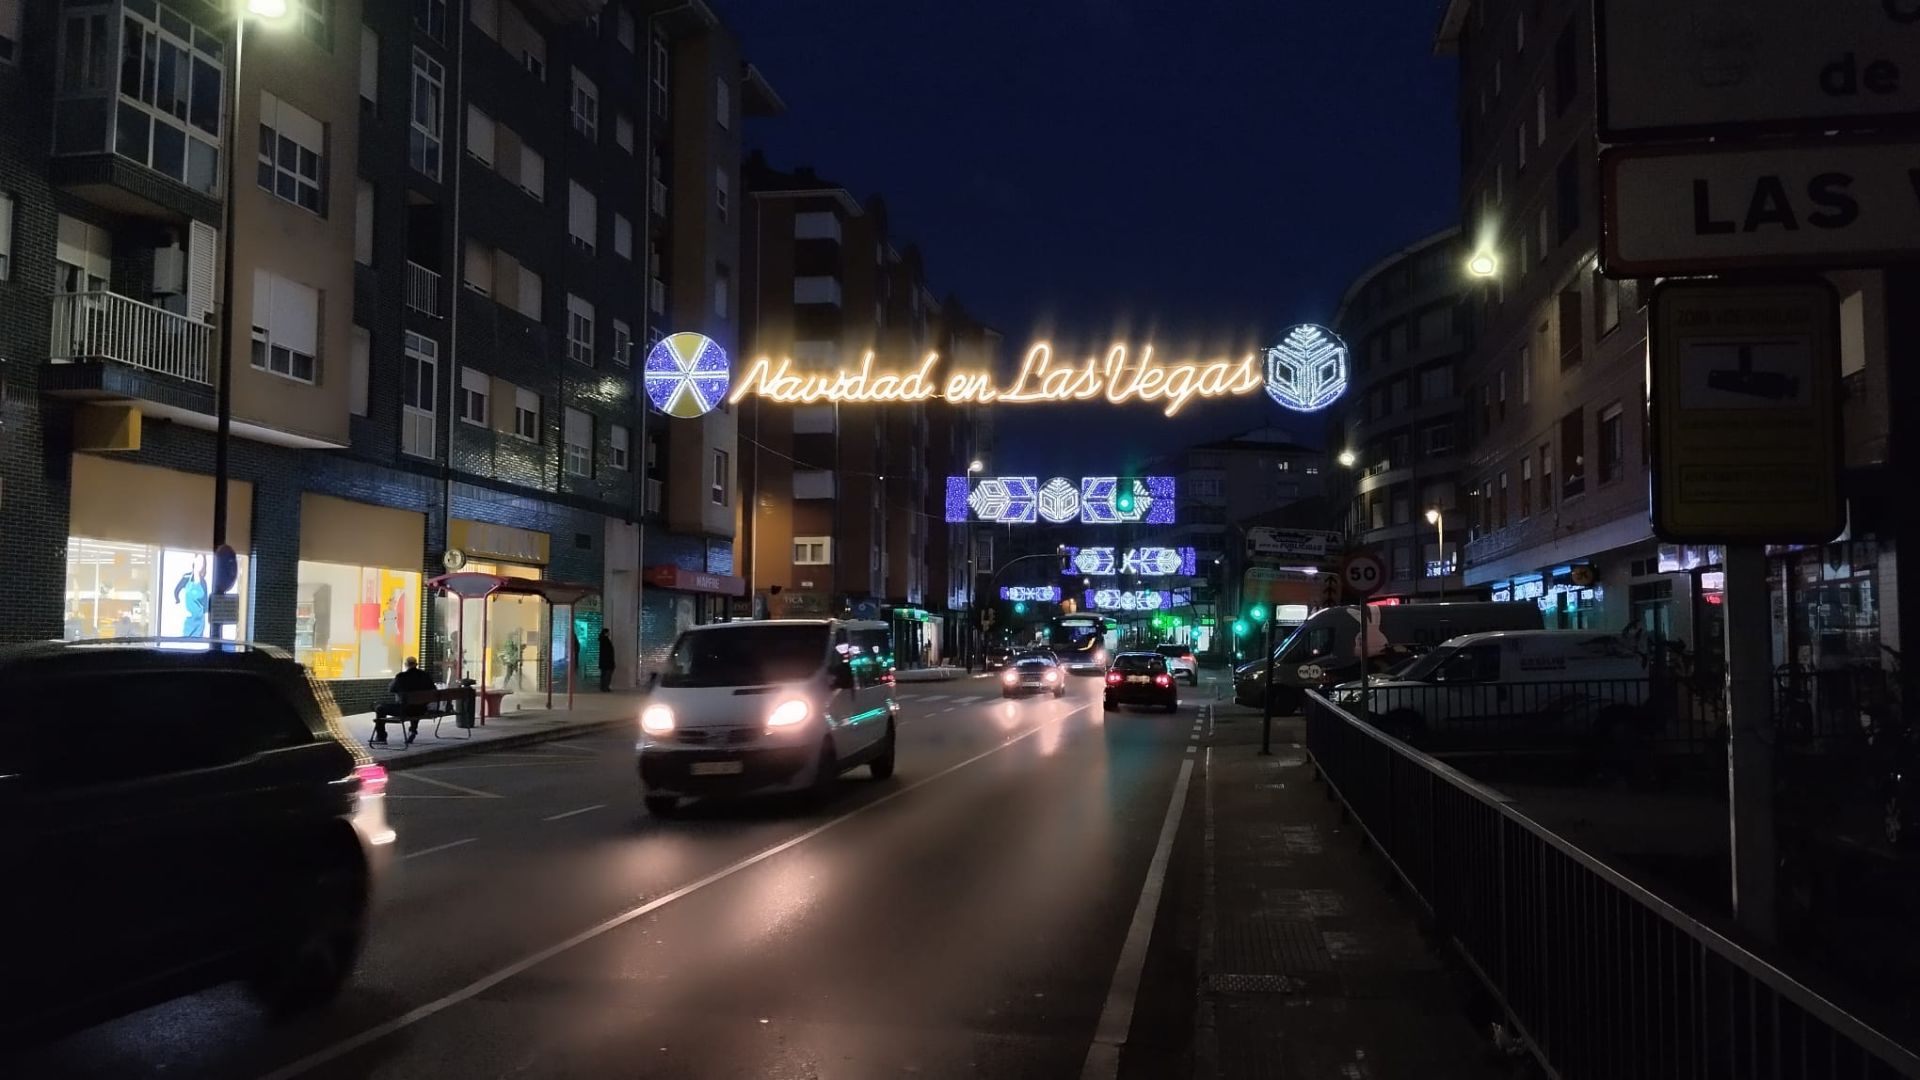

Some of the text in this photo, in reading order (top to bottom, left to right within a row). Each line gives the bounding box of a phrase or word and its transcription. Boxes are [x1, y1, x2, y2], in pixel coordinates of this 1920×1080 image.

[1820, 52, 1900, 96] de
[1693, 172, 1859, 235] LAS
[730, 350, 939, 404] Navidad
[946, 374, 996, 403] en
[1350, 566, 1377, 581] 50
